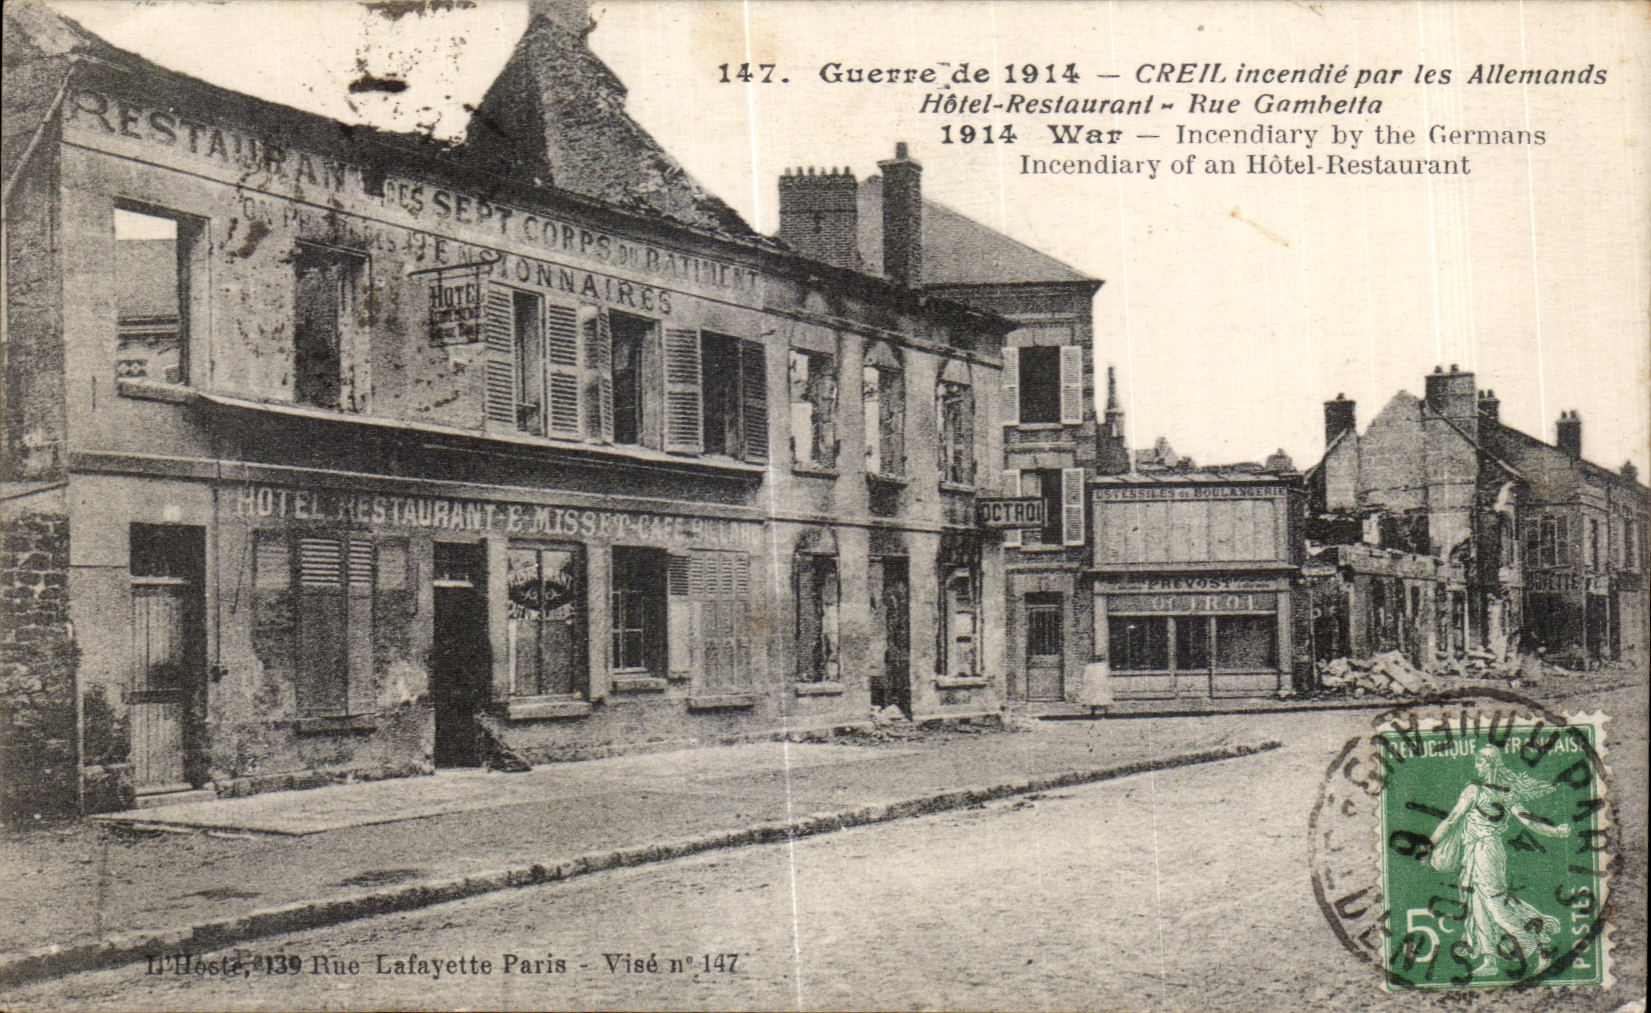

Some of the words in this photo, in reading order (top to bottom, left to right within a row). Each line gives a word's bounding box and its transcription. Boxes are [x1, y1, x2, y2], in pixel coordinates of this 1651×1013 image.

[432, 188, 514, 236] SEPT
[523, 213, 612, 260] CORPS
[617, 244, 641, 268] DU
[236, 486, 328, 521] HOTEL
[980, 499, 1045, 523] OCTROI
